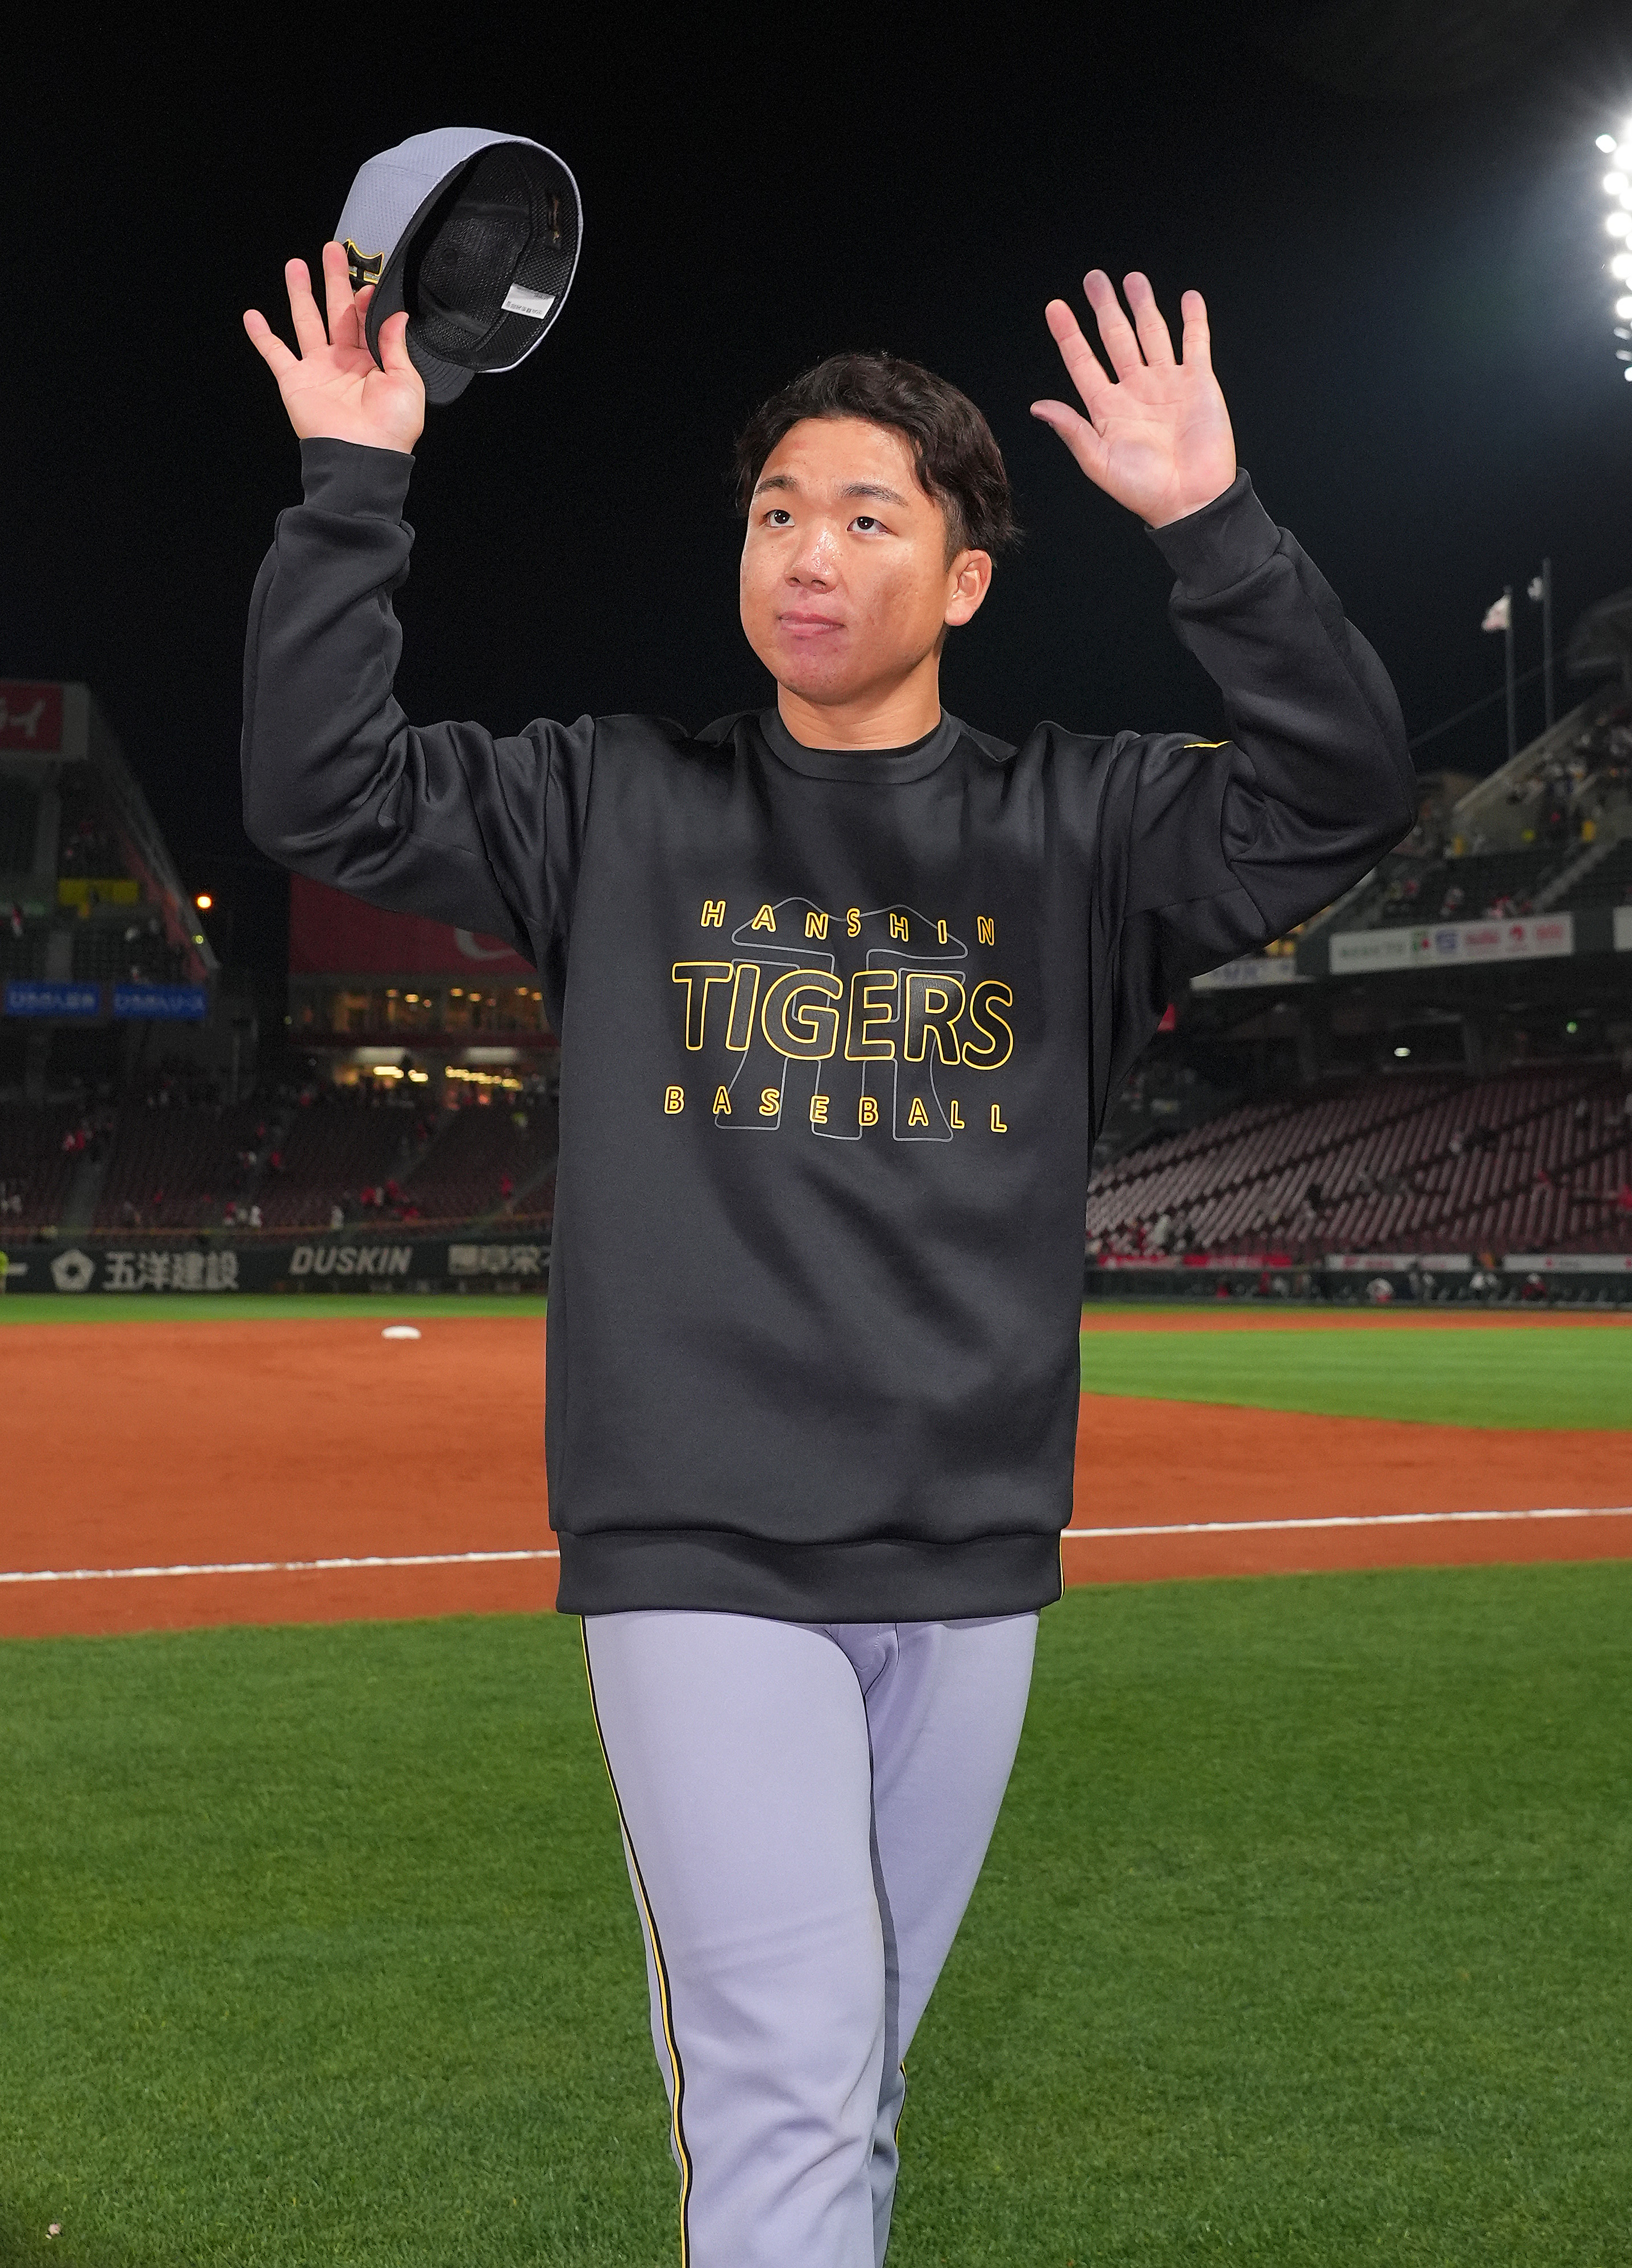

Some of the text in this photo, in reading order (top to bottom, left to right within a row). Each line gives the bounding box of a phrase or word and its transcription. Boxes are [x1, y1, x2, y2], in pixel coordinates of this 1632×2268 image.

[700, 900, 996, 946] HANSHIN
[672, 961, 1014, 1071] TIGERS
[664, 1085, 1008, 1133] BASEBALL
[103, 1251, 239, 1291] 五洋建設
[289, 1246, 413, 1275] DUSKIN
